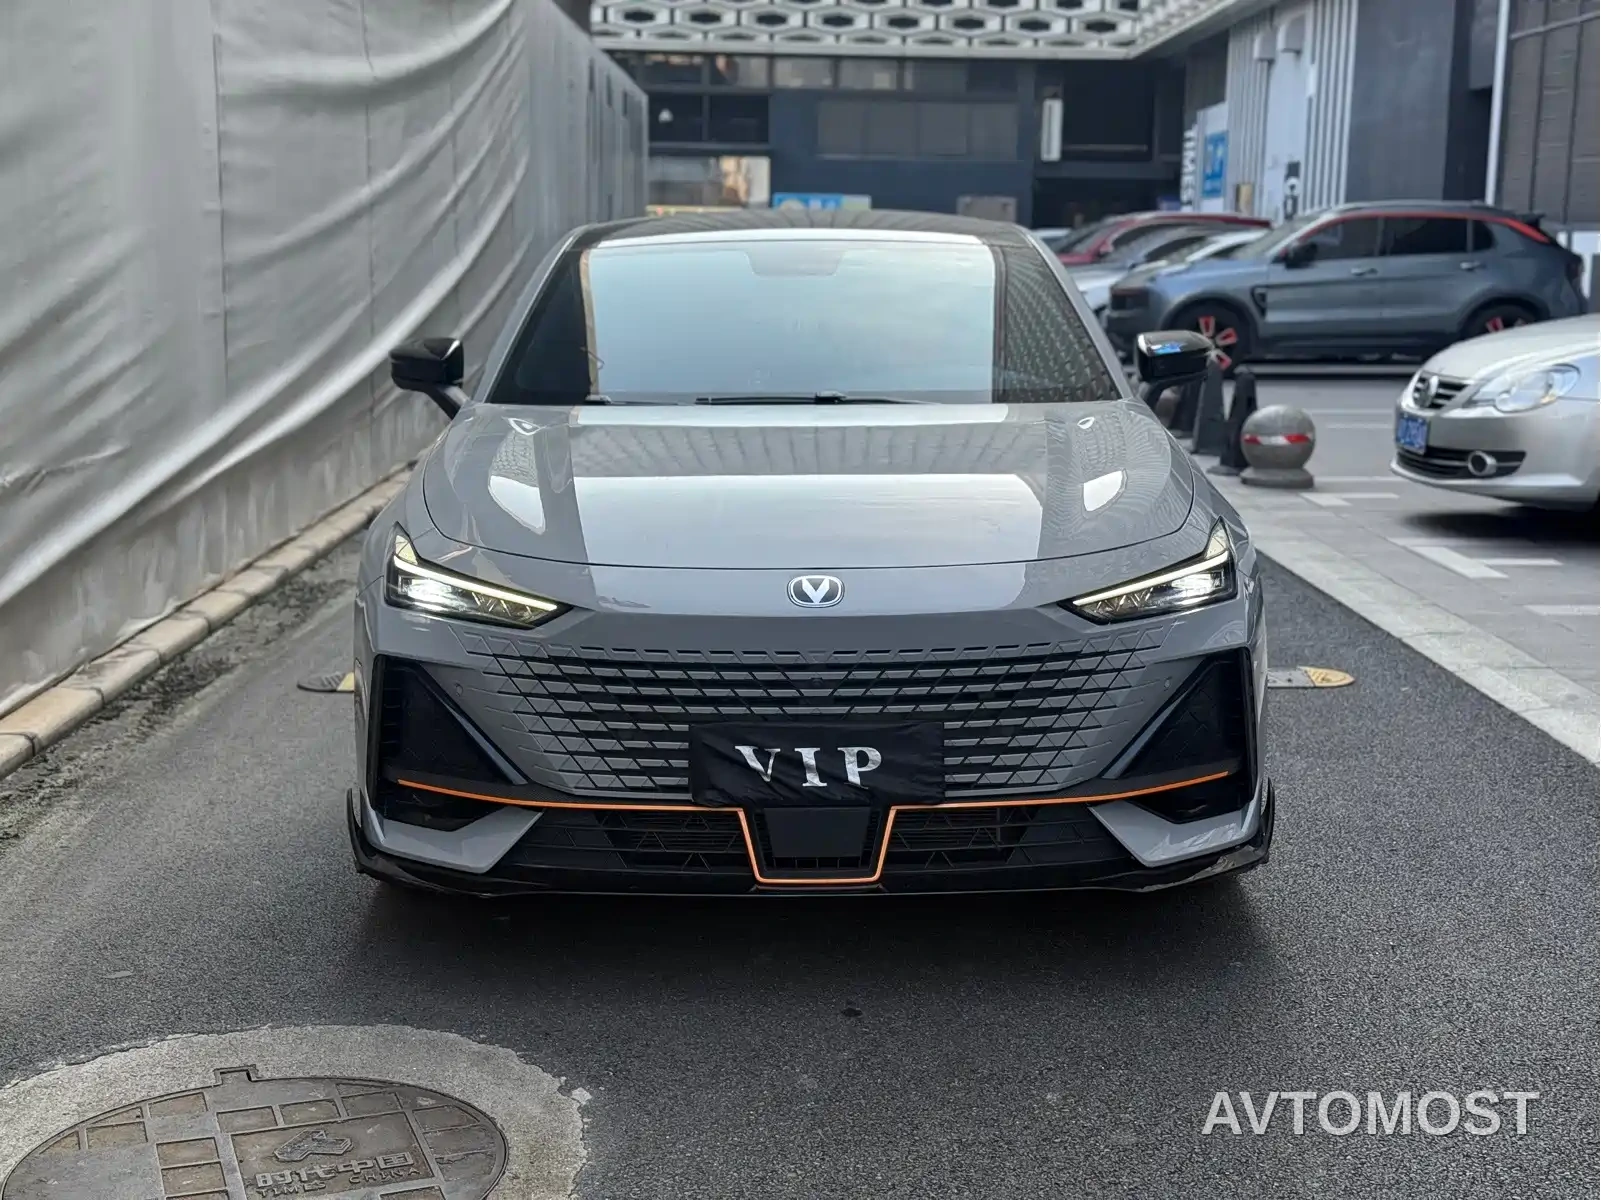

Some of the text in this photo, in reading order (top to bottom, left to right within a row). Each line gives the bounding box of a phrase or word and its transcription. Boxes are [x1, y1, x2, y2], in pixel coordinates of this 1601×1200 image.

[1181, 124, 1198, 203] TIMES
[734, 745, 882, 790] VIP
[255, 1151, 414, 1188] 时代中国
[256, 1166, 421, 1197] TIMES CHINA
